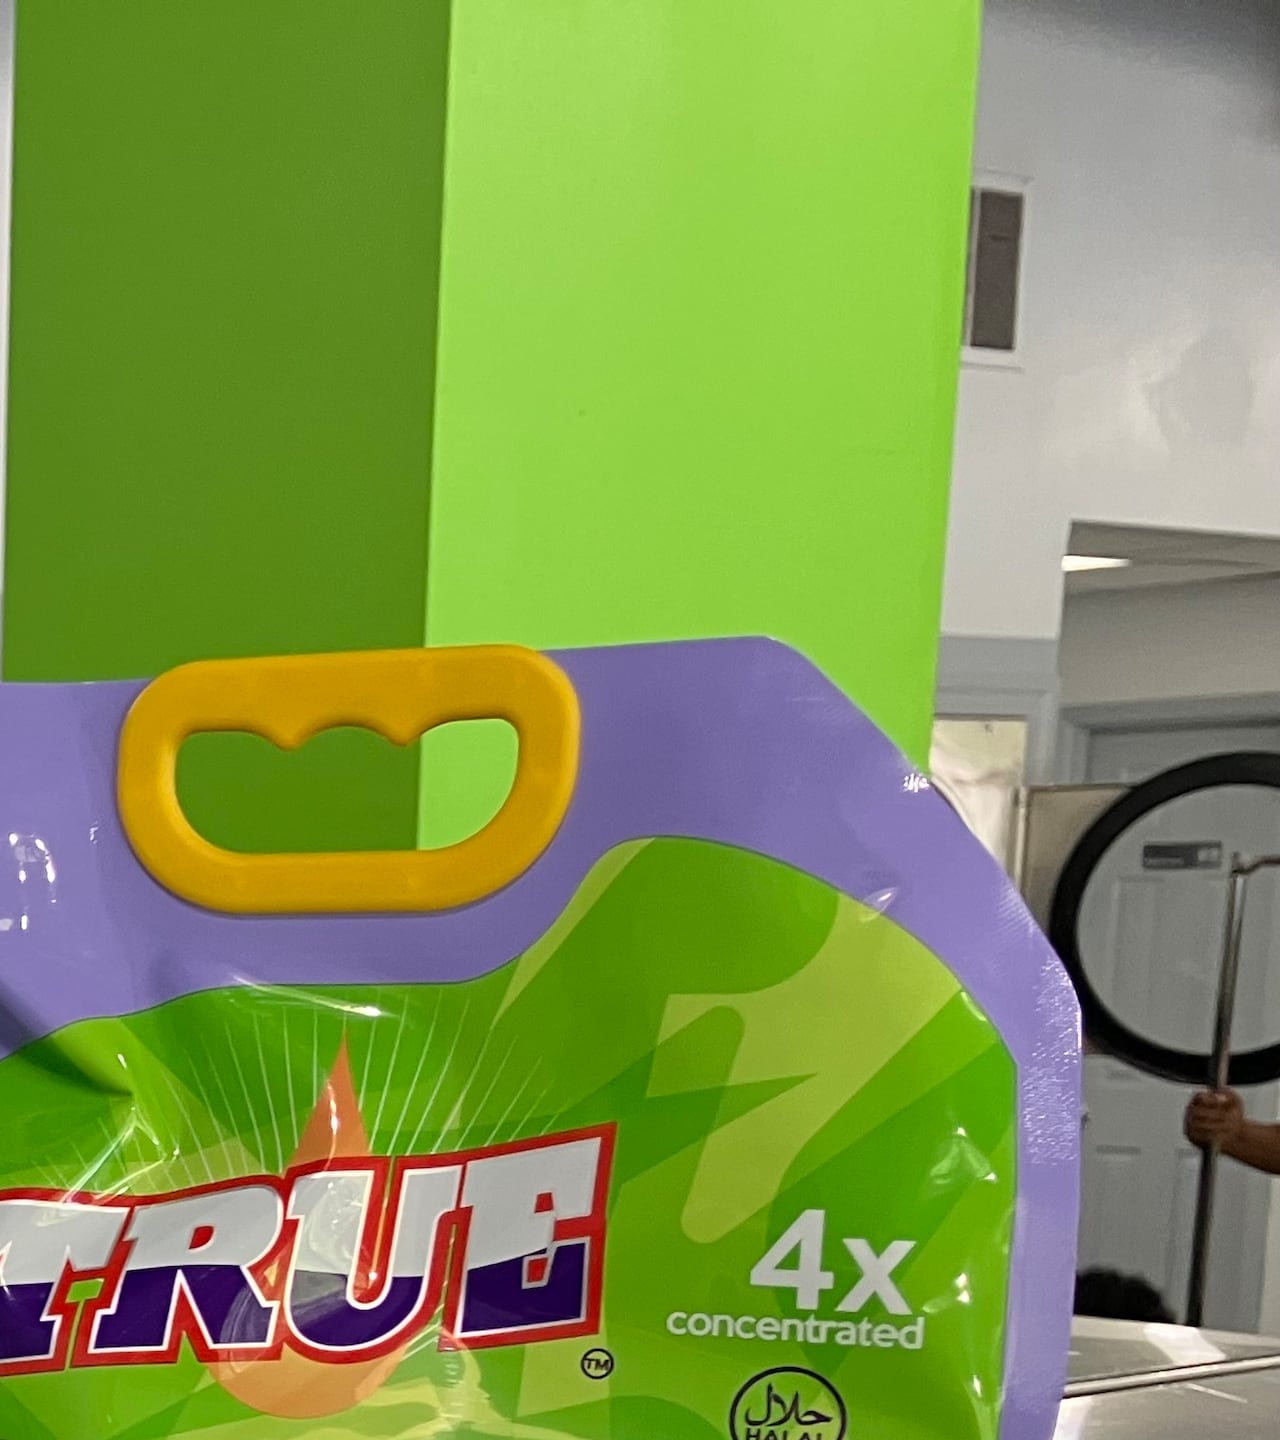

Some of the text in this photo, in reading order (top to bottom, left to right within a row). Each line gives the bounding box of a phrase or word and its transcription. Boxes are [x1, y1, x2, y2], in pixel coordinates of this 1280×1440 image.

[750, 1209, 917, 1316] 4x
[665, 1311, 926, 1350] concentrated
[743, 1382, 834, 1427] حلال
